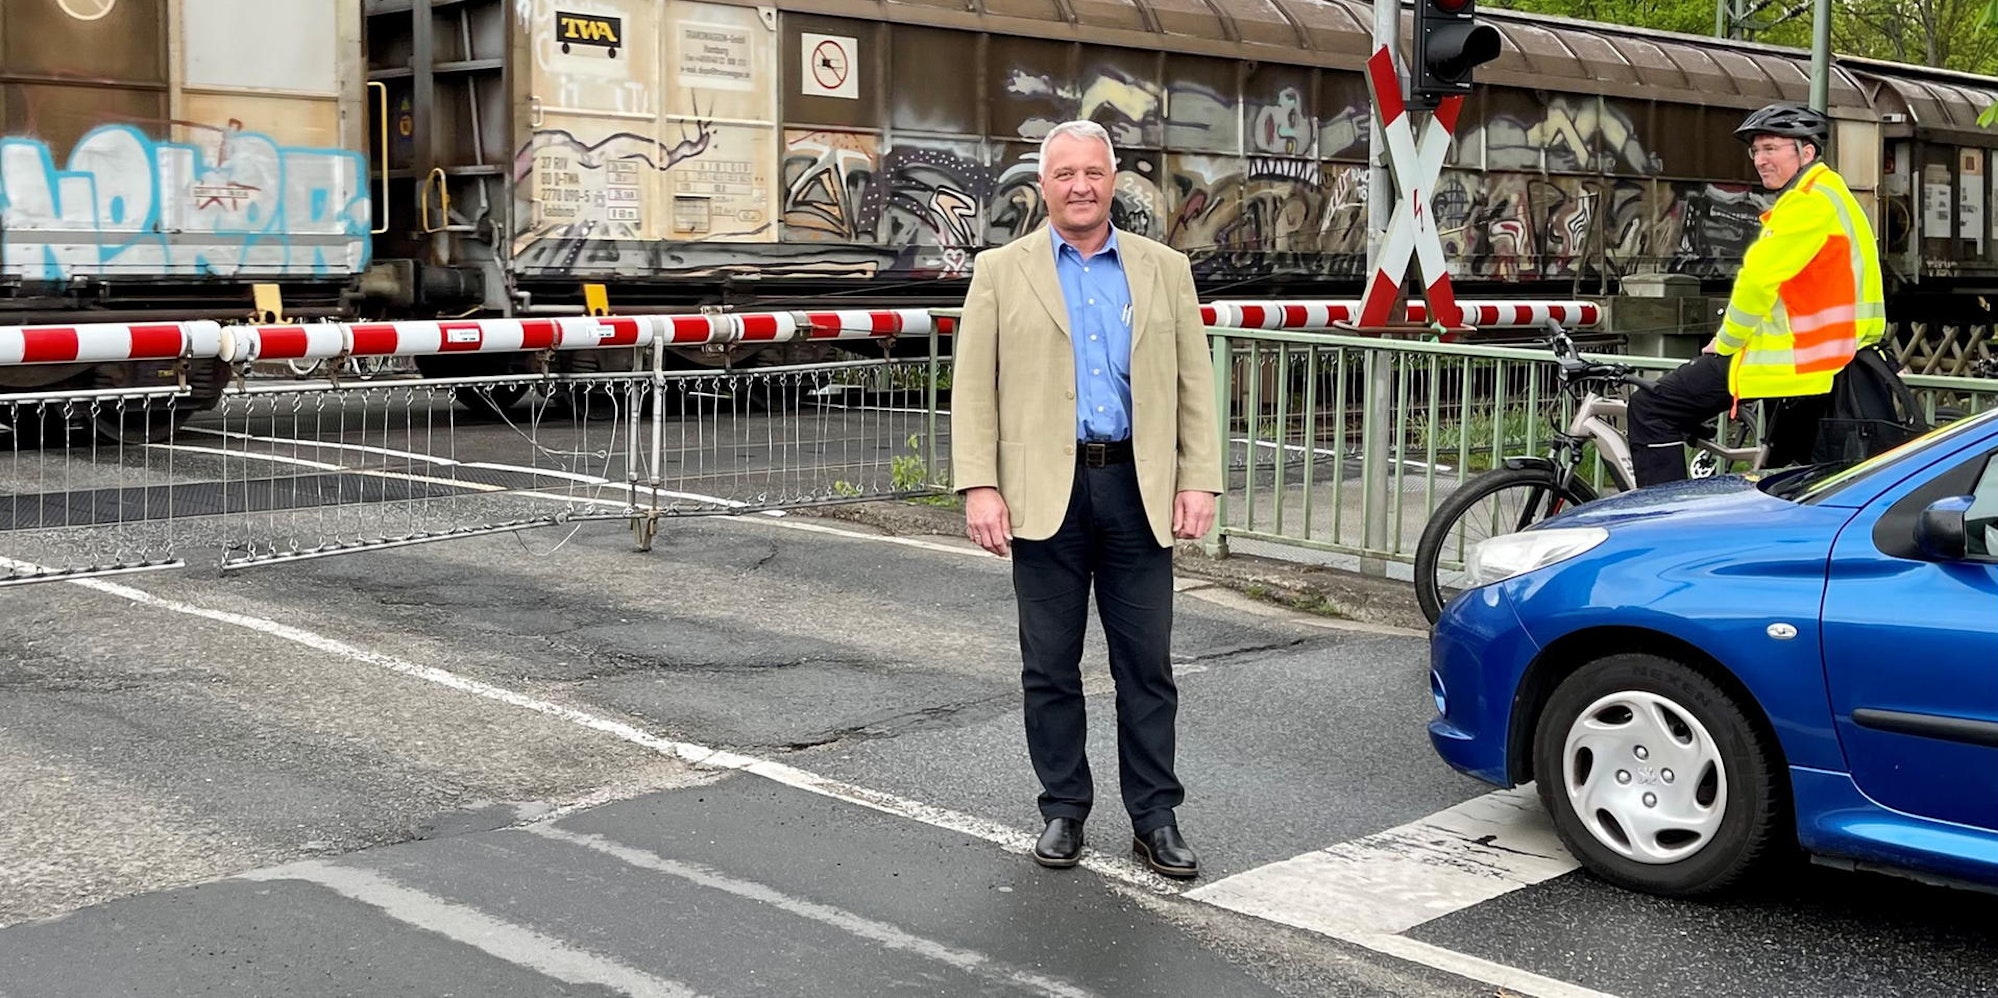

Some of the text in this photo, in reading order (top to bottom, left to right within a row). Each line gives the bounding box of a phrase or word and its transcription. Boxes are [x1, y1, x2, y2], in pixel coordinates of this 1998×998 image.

[561, 17, 618, 43] TWA
[554, 157, 568, 170] RIV
[1632, 665, 1712, 708] NEXEN
